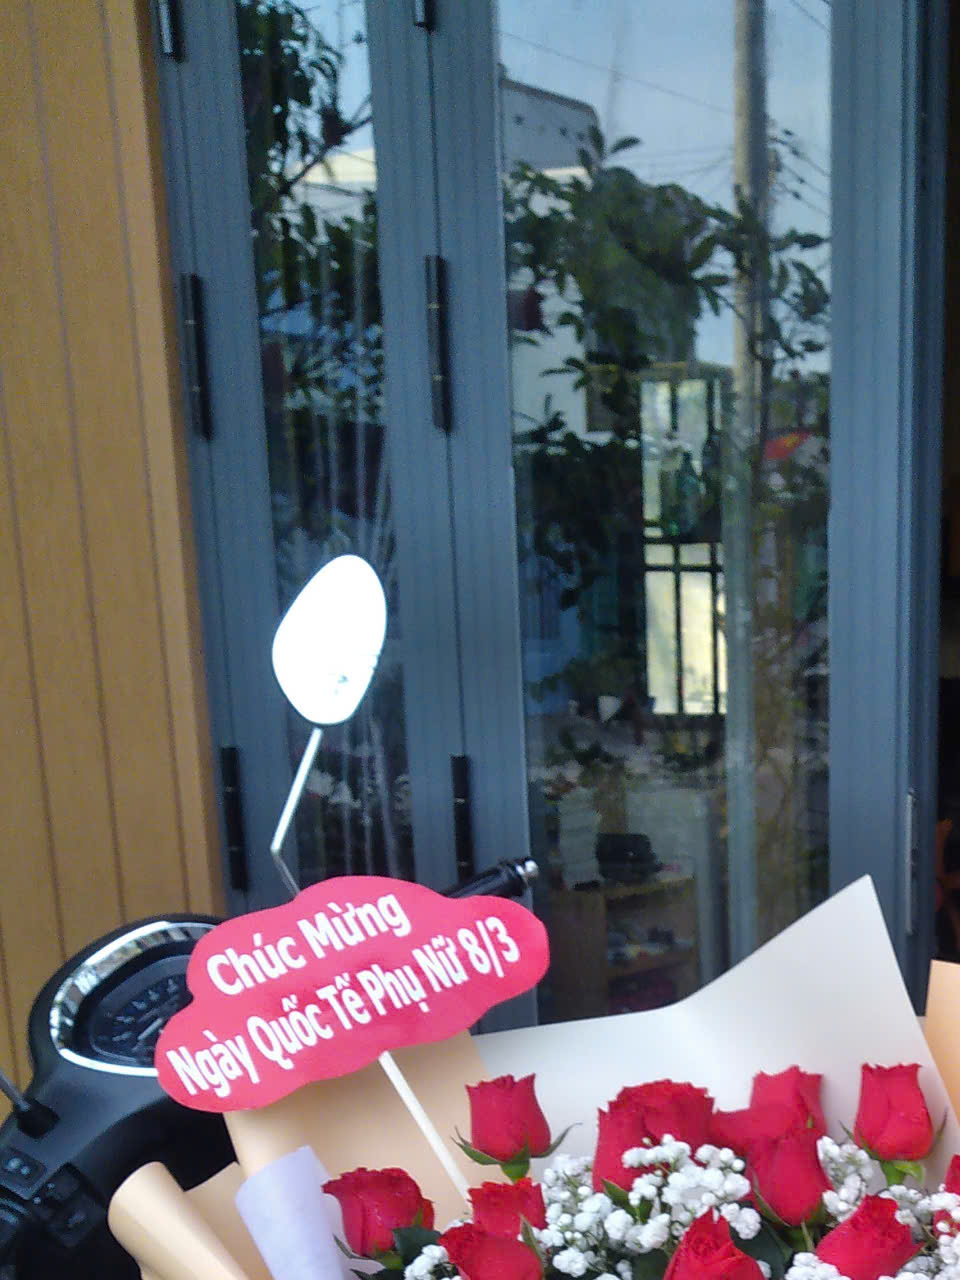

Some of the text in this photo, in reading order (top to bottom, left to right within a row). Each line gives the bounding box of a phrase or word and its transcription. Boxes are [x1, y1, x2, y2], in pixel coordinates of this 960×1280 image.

[166, 916, 520, 1098] Ngày Quốc Tế Phụ Nữ 8/3
[206, 893, 412, 995] Chúc Mừng
